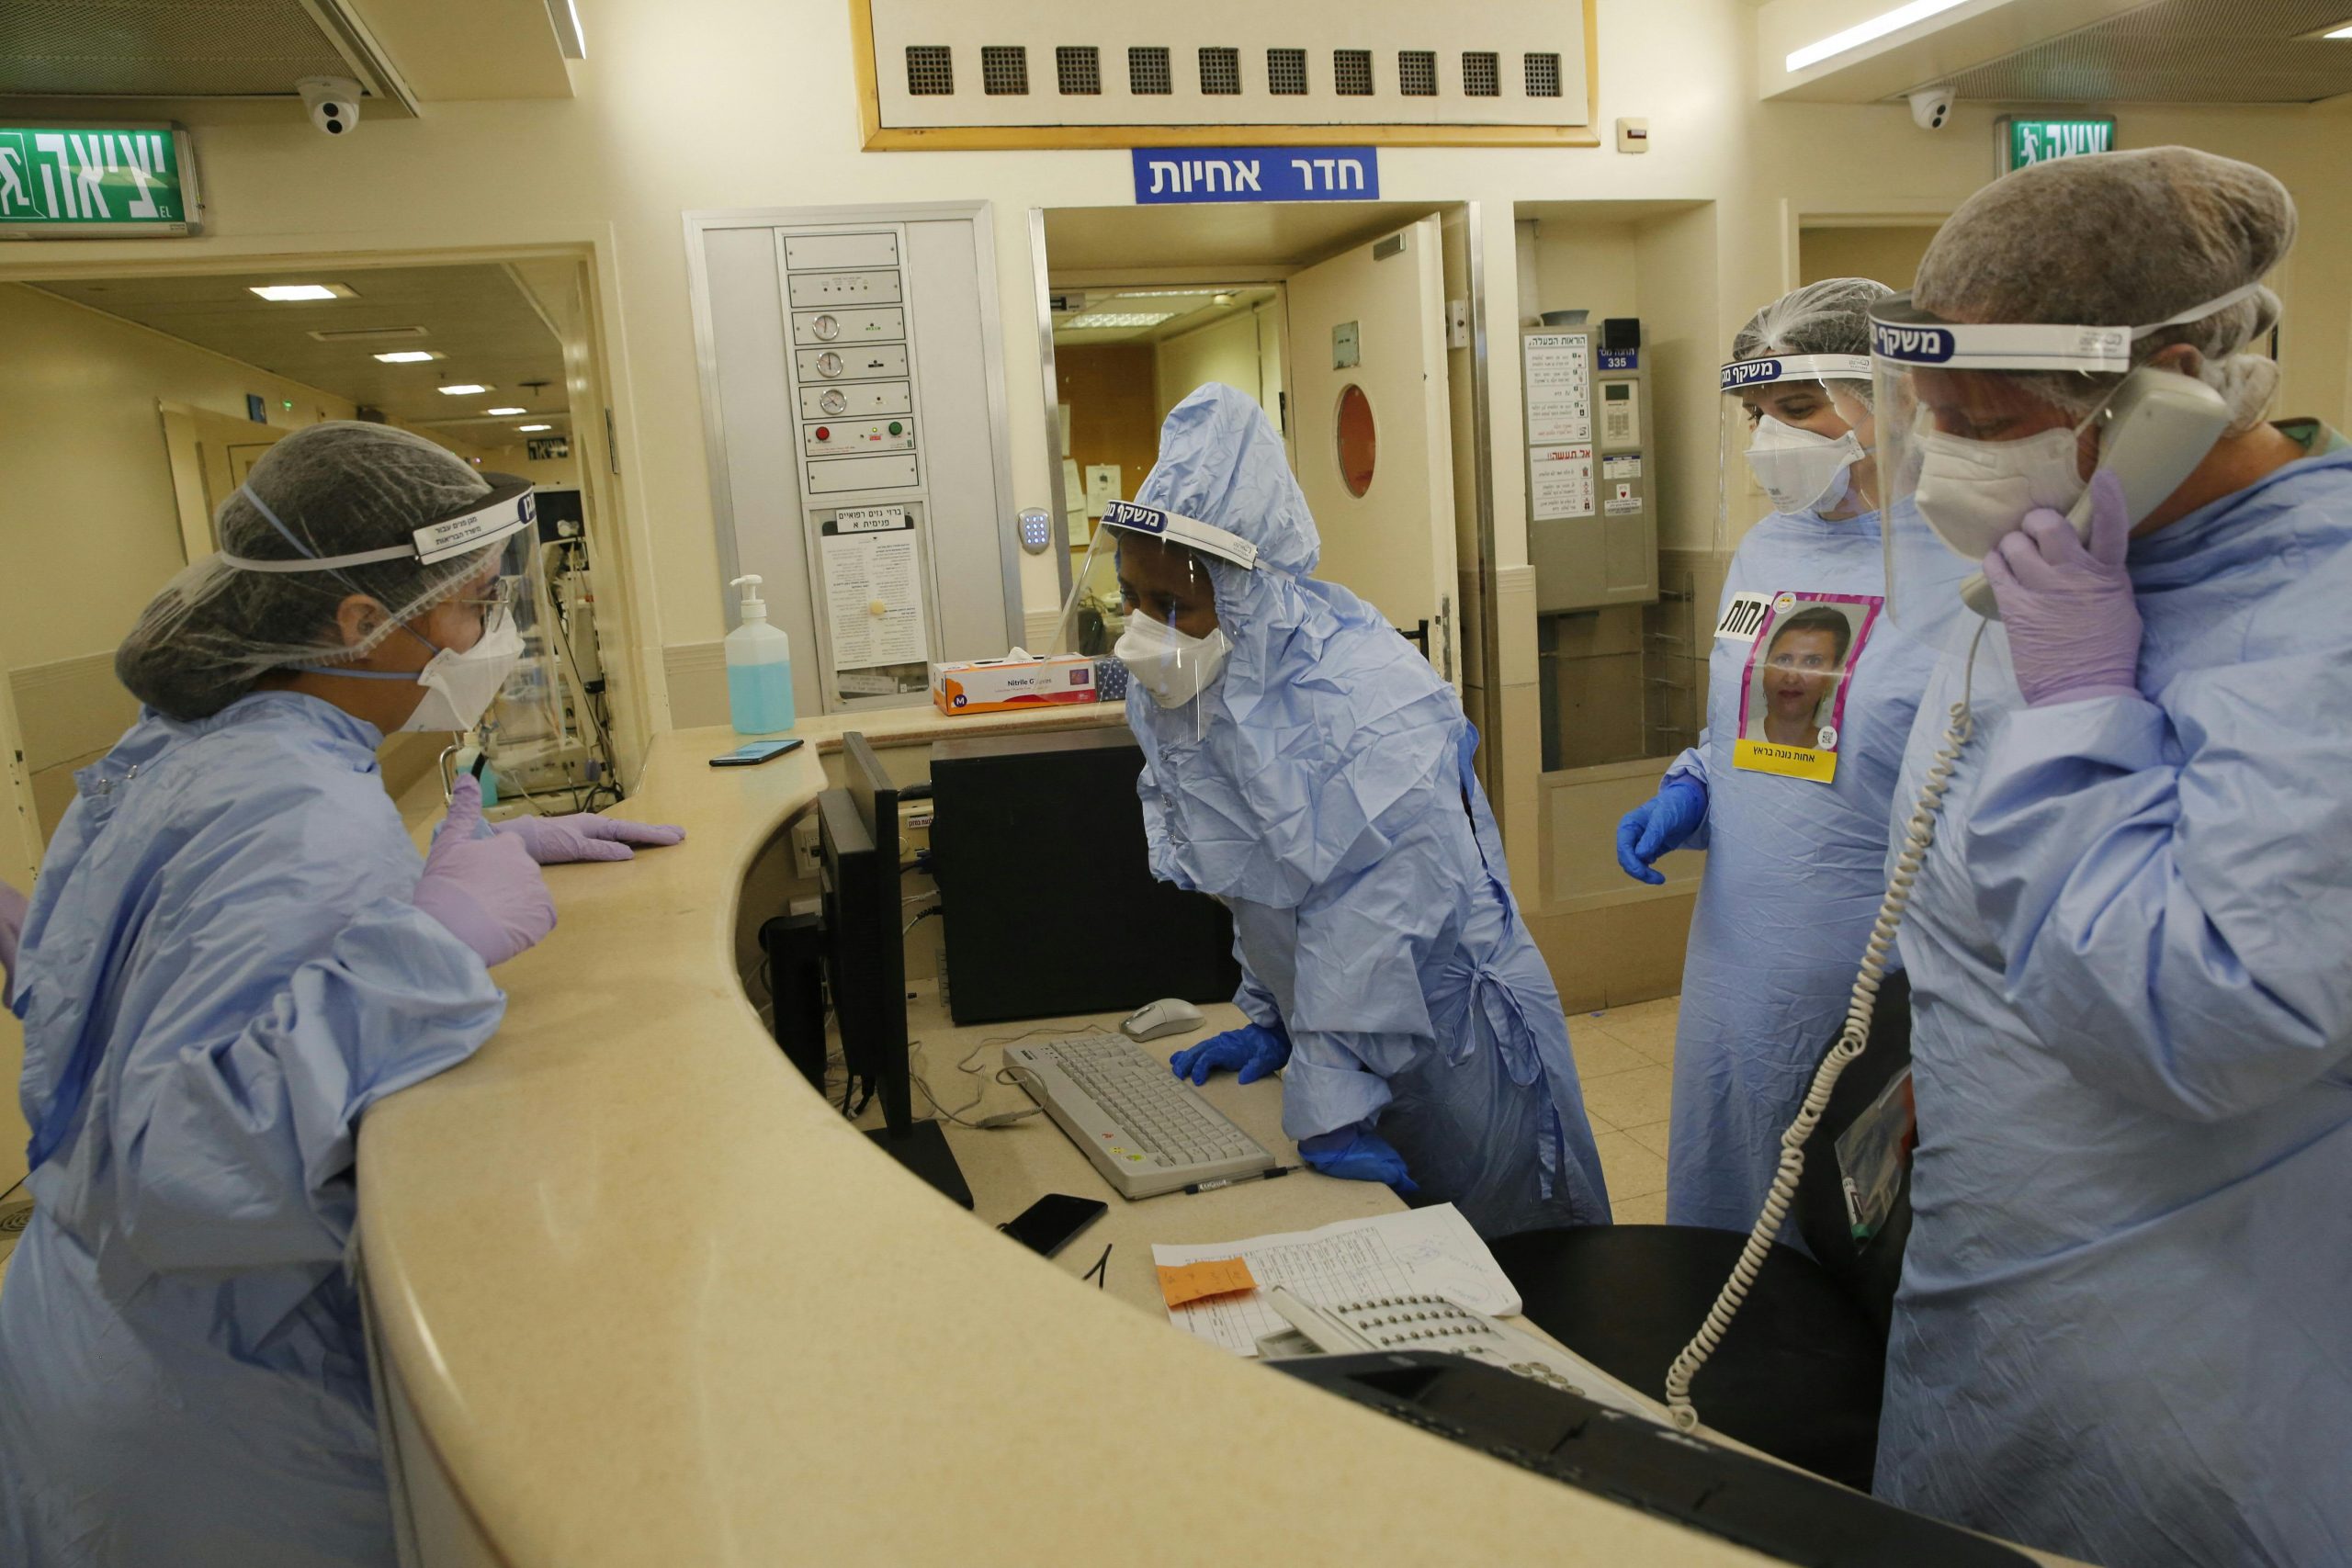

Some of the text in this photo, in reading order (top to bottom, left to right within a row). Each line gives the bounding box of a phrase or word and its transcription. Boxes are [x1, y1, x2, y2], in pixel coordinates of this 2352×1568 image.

[35, 134, 165, 219] יציאה
[1149, 159, 1364, 194] חדר אחיות
[159, 206, 173, 219] EL
[1561, 336, 1586, 345] הוראות
[1879, 326, 1940, 355] משקף
[1608, 357, 1626, 367] 335
[1733, 362, 1773, 384] משקף
[1579, 449, 1590, 458] אל
[839, 511, 865, 520] רפואיים
[868, 510, 883, 518] גזים
[1117, 504, 1159, 527] משקף
[864, 519, 889, 528] פנימית
[956, 697, 965, 705] M
[1753, 746, 1815, 762] אחות נונה בראץ
